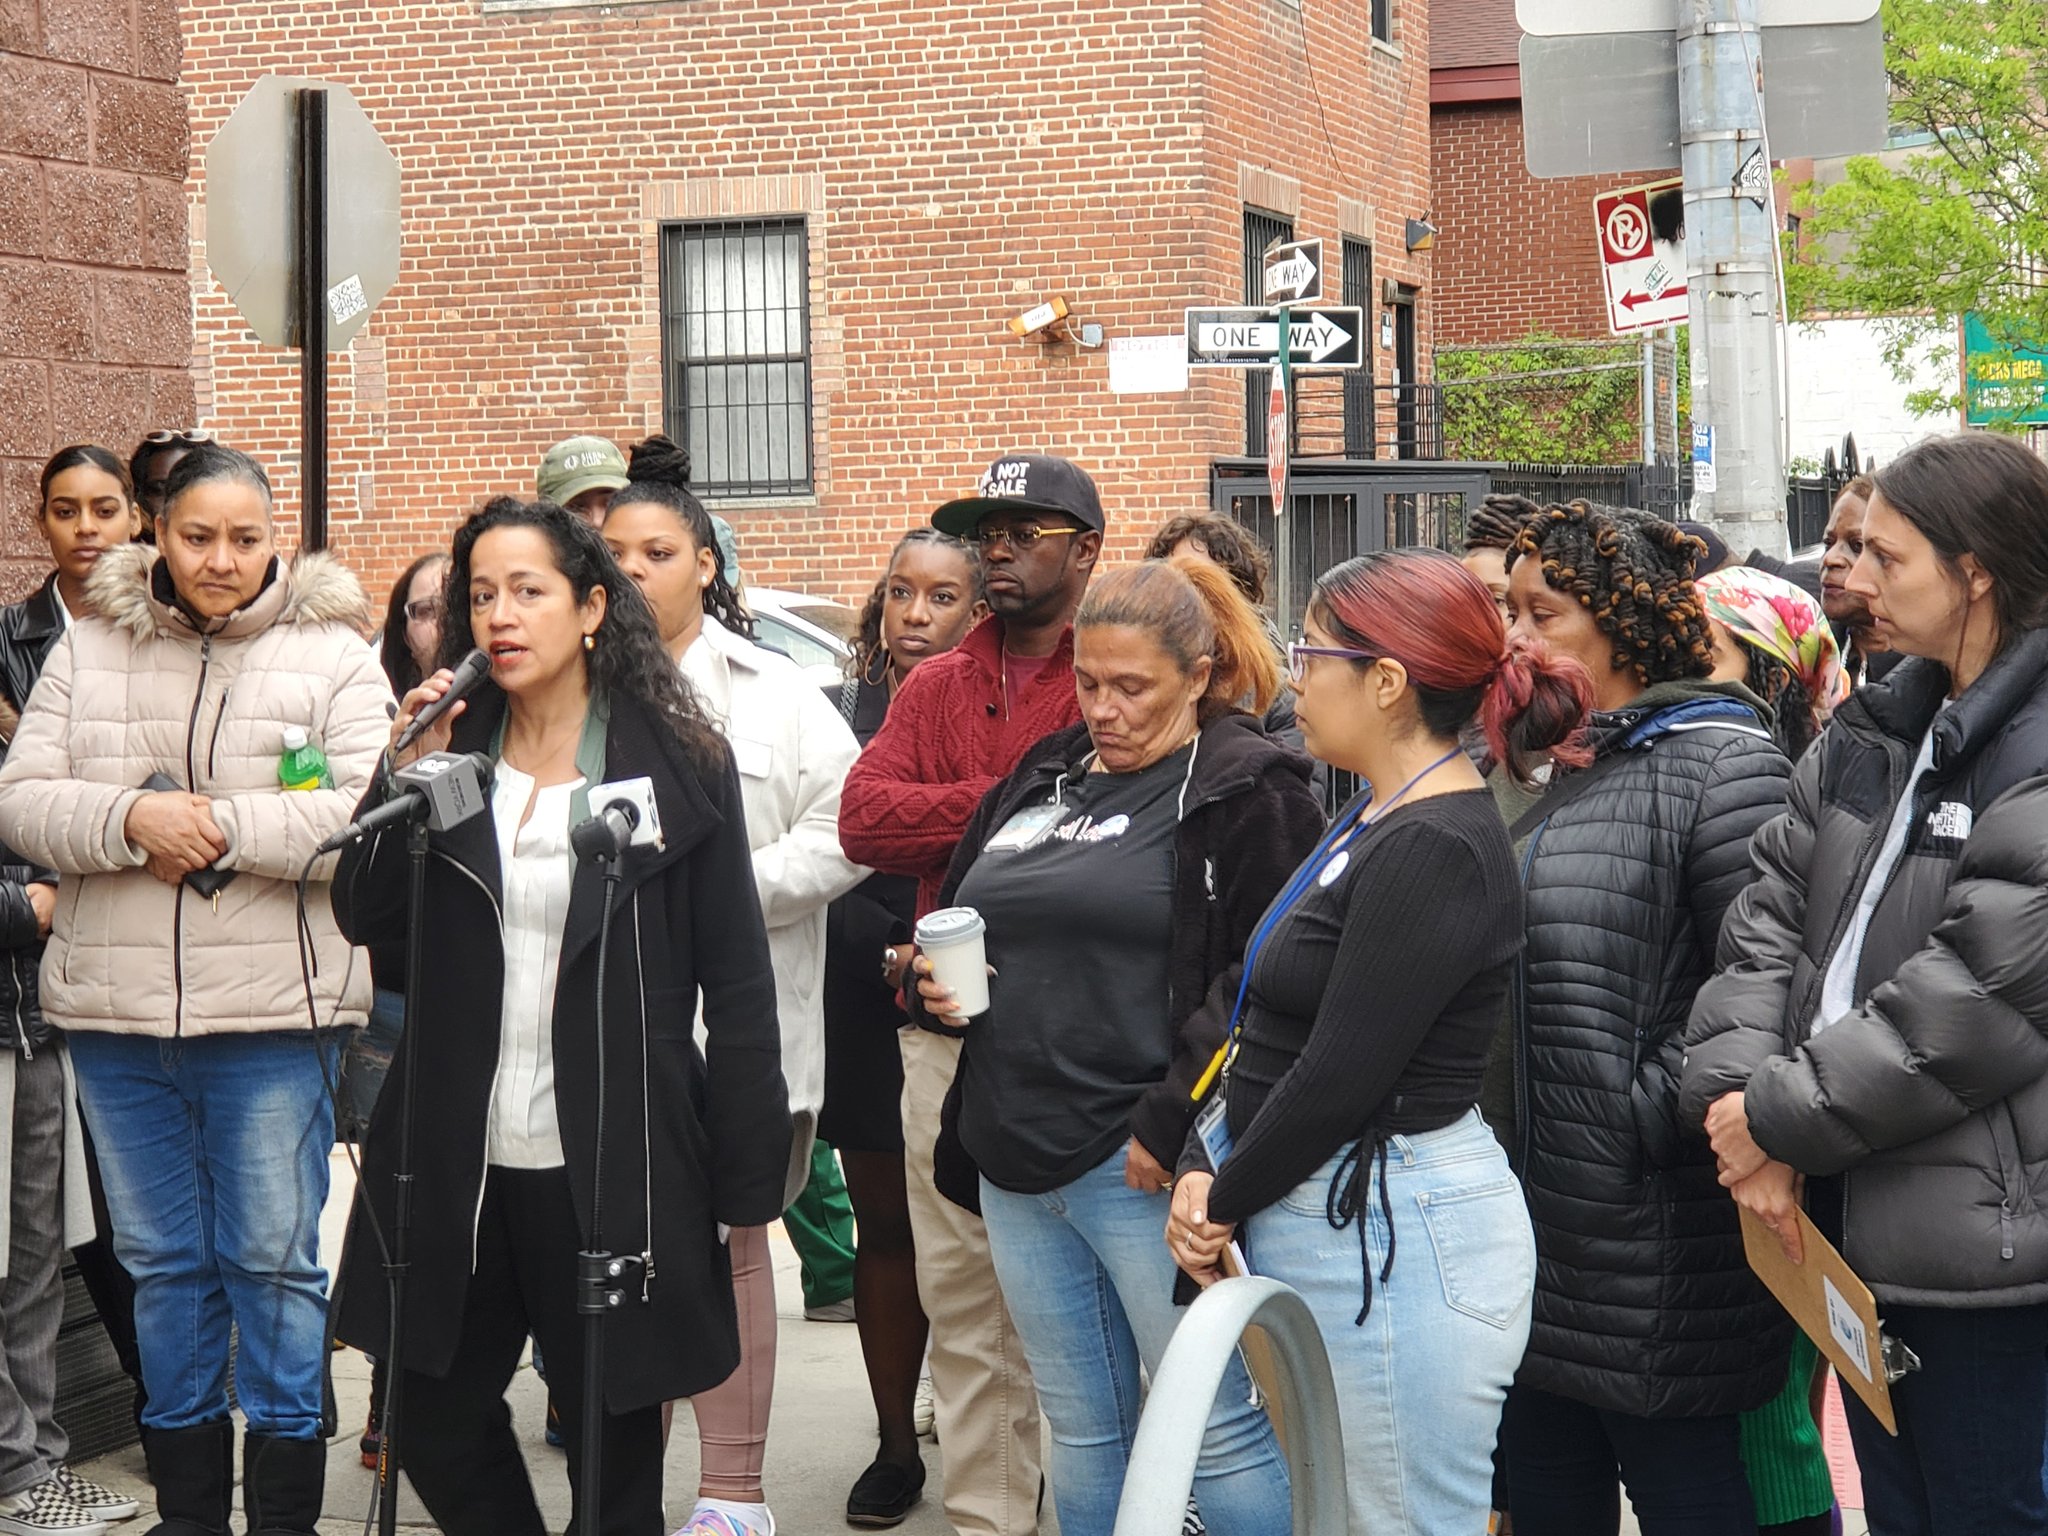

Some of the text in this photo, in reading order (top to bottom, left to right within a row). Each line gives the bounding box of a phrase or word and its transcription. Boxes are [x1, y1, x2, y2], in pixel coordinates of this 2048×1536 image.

[1282, 262, 1308, 286] WAY
[1213, 326, 1334, 348] ONE WAY
[2012, 360, 2043, 379] MEGA
[1269, 412, 1286, 468] STOP
[997, 461, 1031, 480] NOT
[987, 478, 1028, 499] SALE
[1940, 801, 1957, 814] THE
[1927, 811, 1956, 826] NORTH
[1932, 824, 1955, 837] FACE
